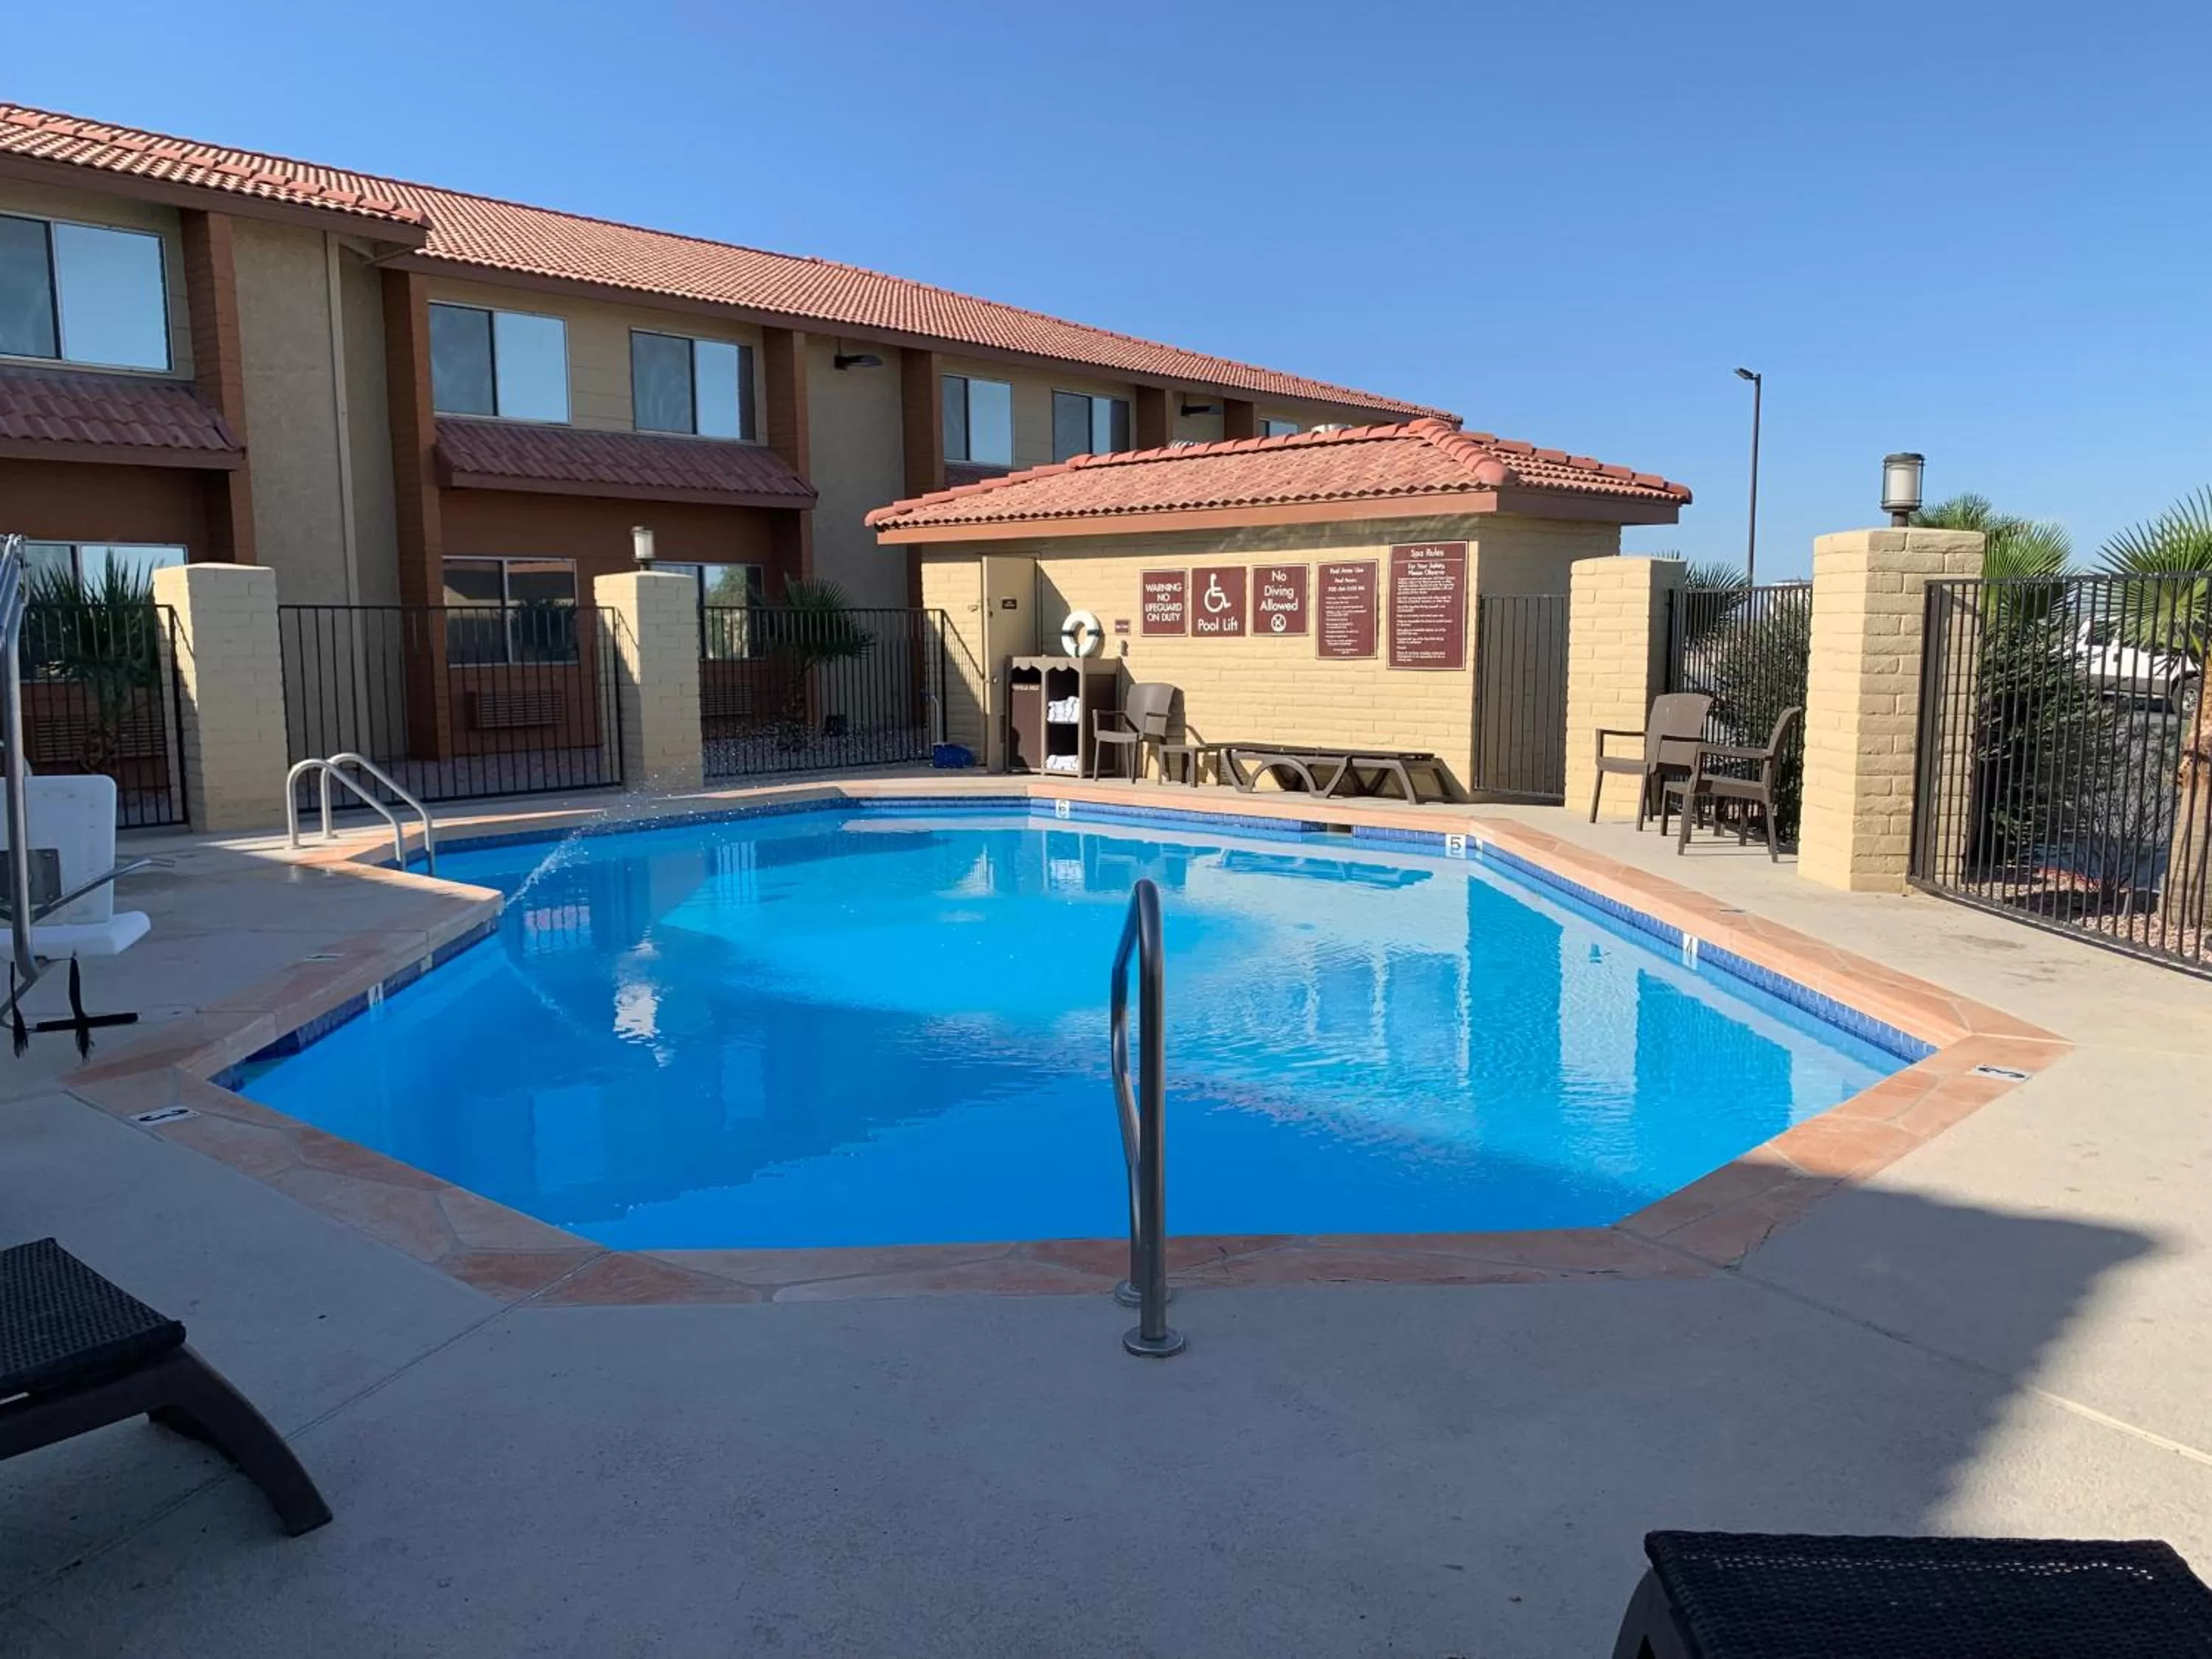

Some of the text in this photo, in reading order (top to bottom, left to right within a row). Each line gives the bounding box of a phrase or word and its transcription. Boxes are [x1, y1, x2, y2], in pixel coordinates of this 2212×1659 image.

[1411, 546, 1444, 558] Spa Rules
[1272, 570, 1287, 582] No
[1145, 582, 1183, 592] WARNING
[1264, 585, 1294, 599] Diving
[1157, 592, 1171, 602] NO
[1145, 602, 1183, 613] LIFEGUARD
[1259, 597, 1298, 611] Allowed
[1147, 613, 1180, 622] ON DUTY
[1197, 616, 1239, 631] Pool Lift
[1450, 836, 1461, 849] 5
